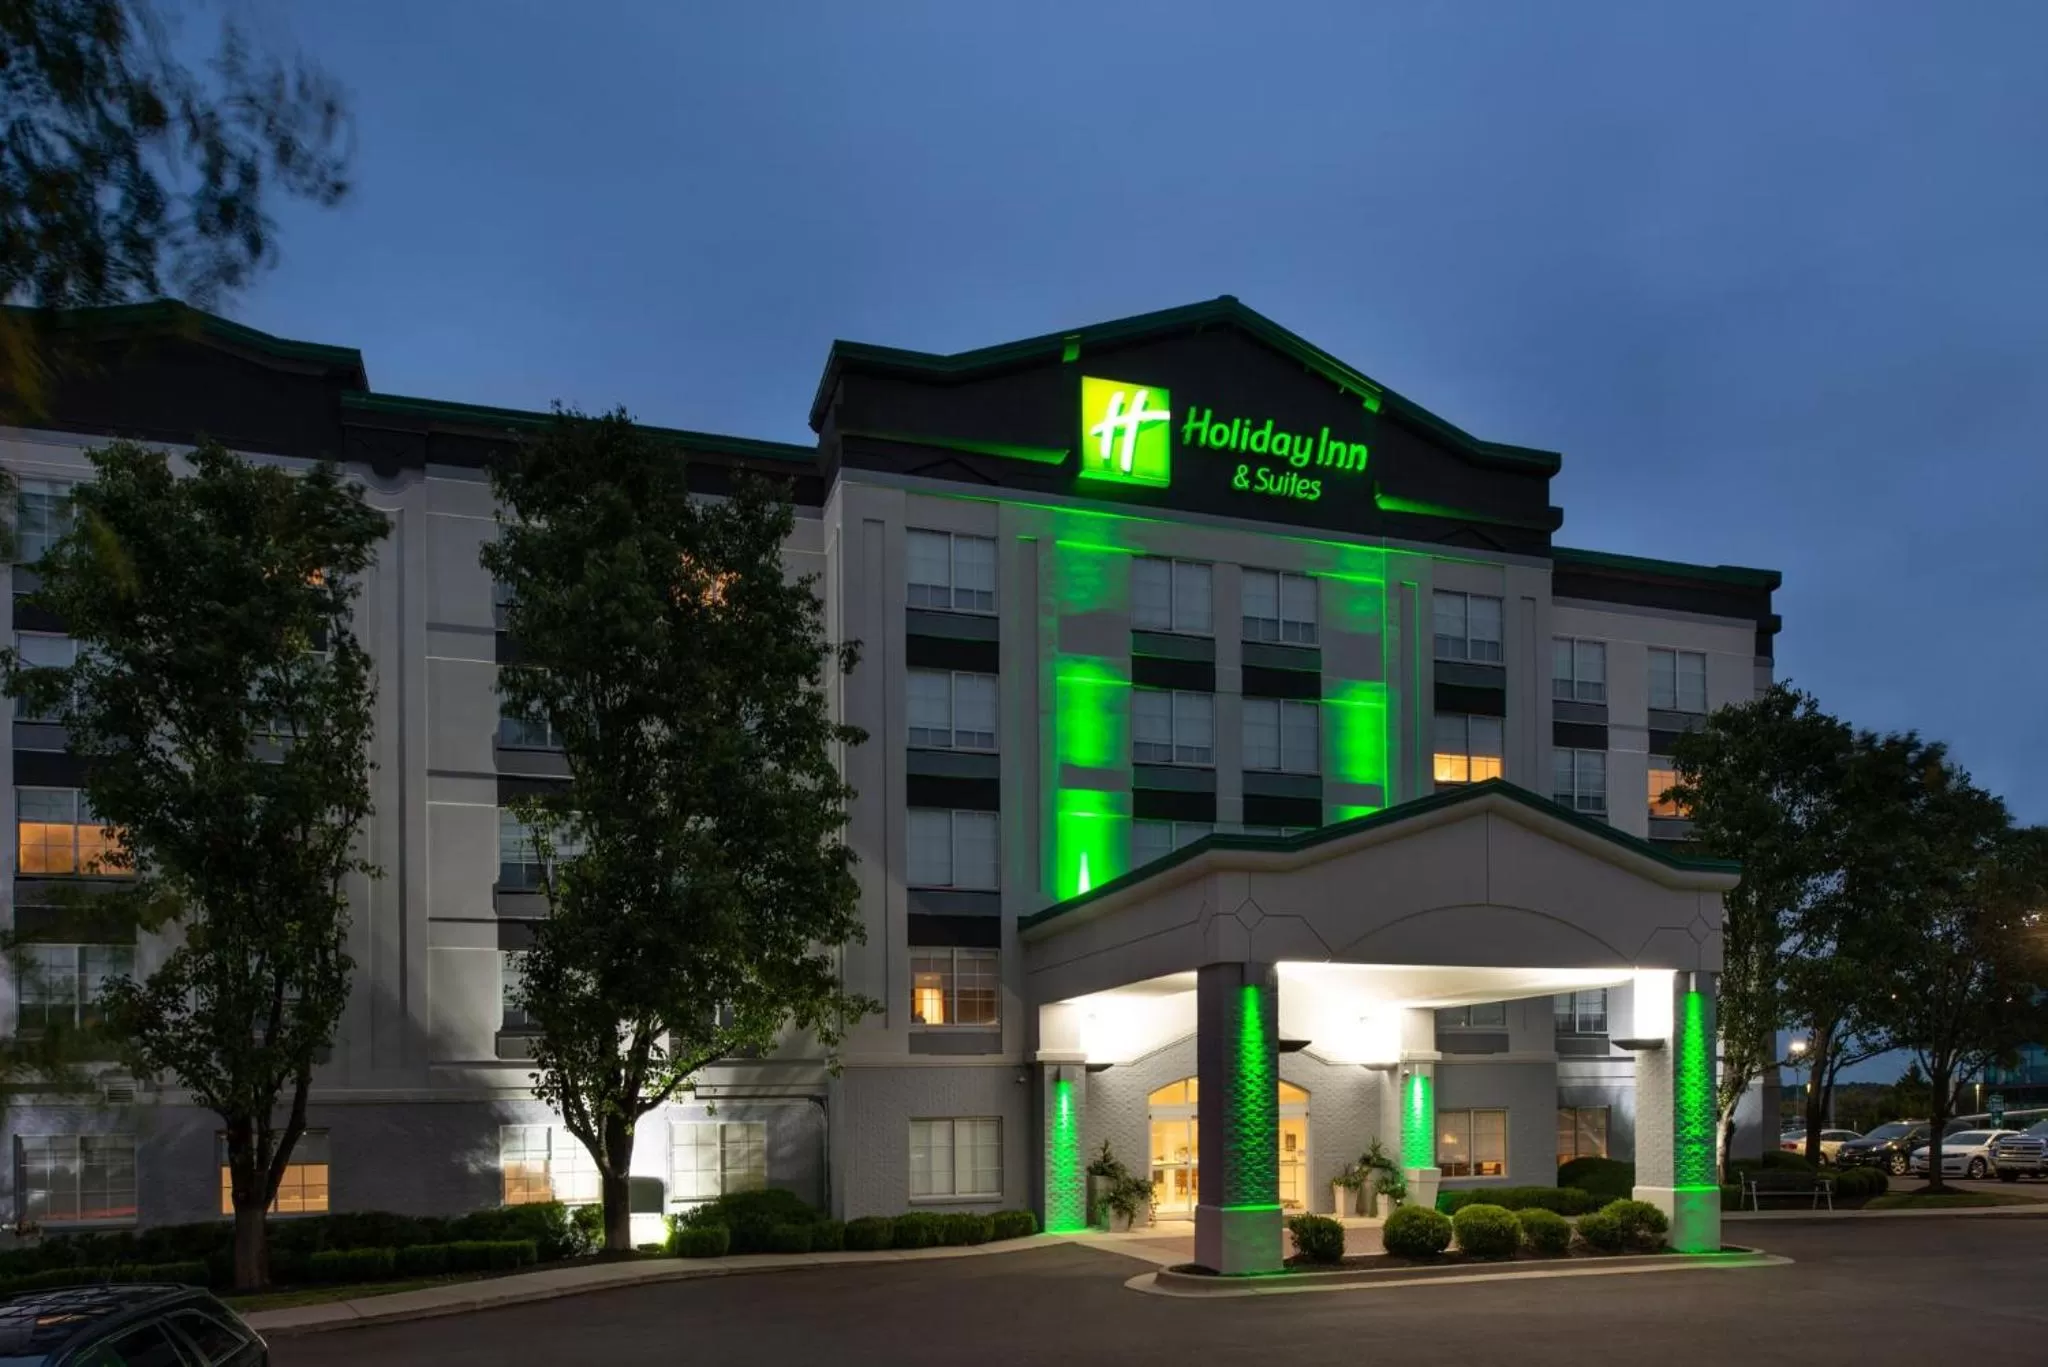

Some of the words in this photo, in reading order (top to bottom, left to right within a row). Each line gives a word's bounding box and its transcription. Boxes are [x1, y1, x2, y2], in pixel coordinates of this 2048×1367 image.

[1182, 406, 1313, 467] Holiday
[1316, 427, 1368, 471] Inn
[1232, 465, 1250, 489] &
[1254, 468, 1322, 501] Suites
